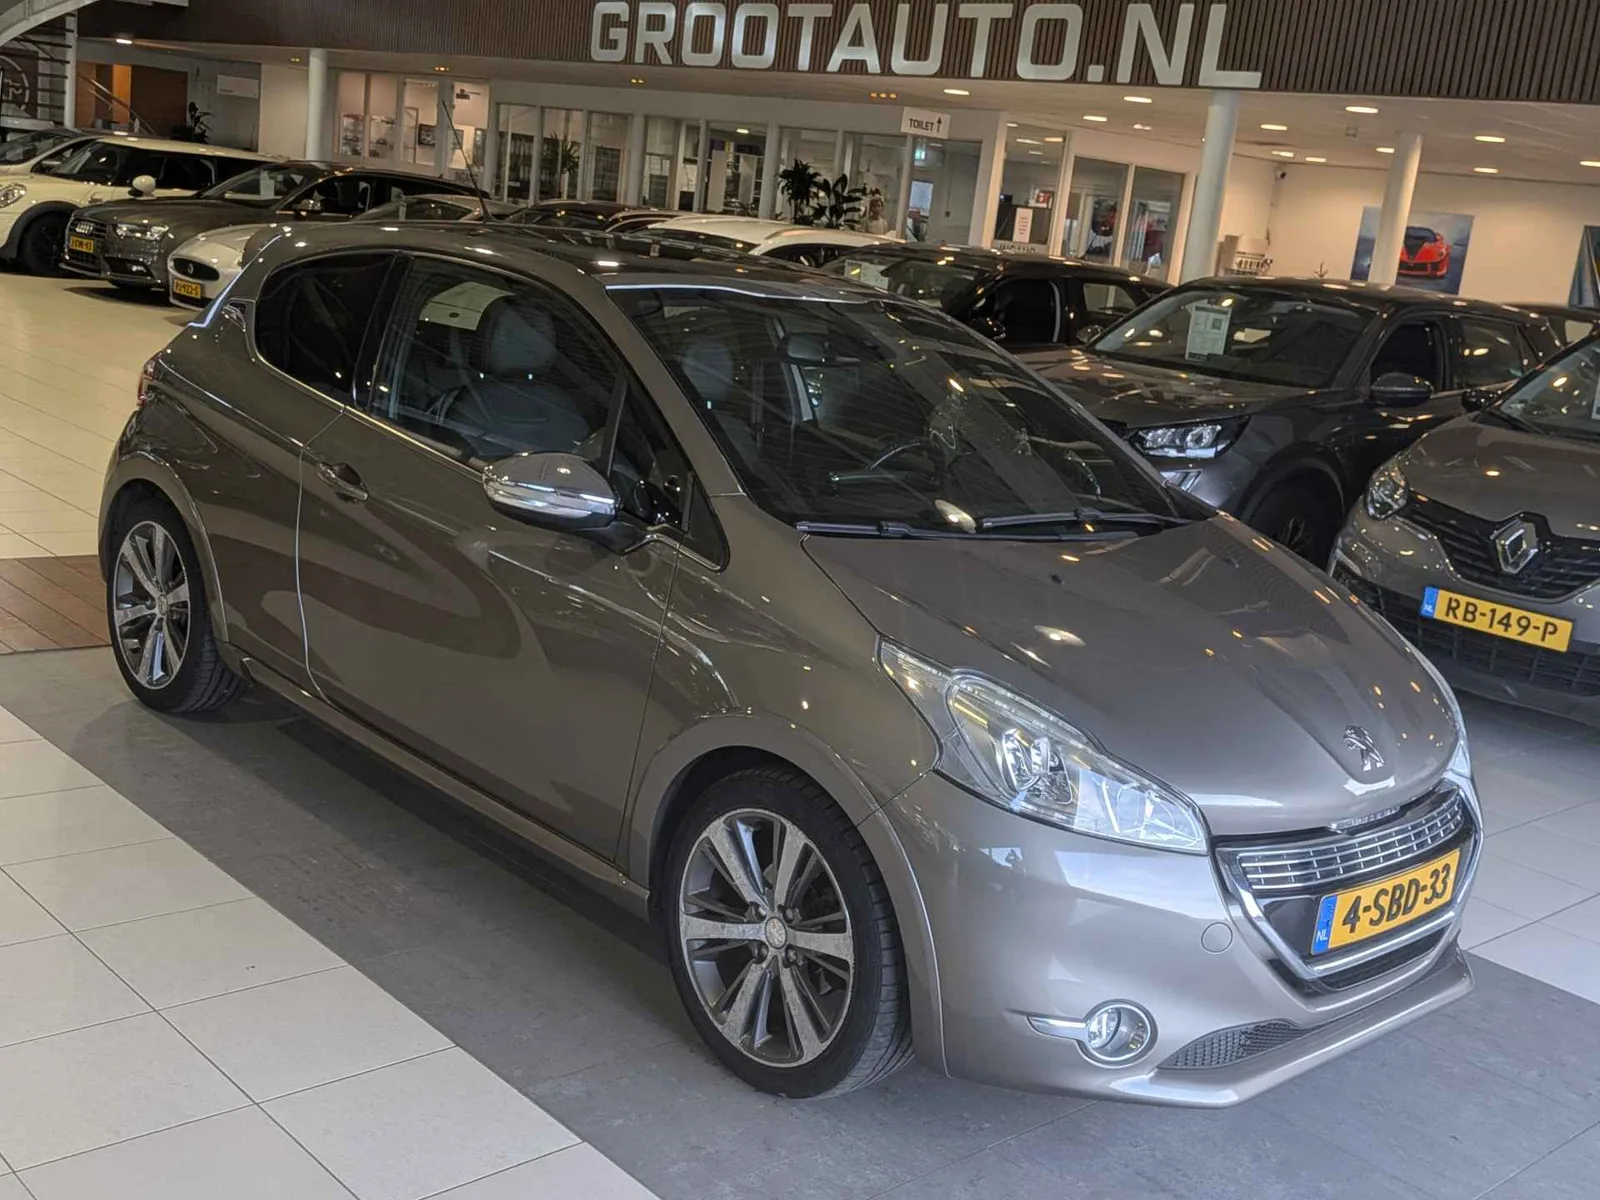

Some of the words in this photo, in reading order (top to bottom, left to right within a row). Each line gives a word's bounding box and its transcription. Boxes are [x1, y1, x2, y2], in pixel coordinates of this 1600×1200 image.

[591, 1, 1262, 88] GROOTAUTO.NL
[909, 118, 934, 131] TOILET
[1445, 597, 1558, 642] RB-149-P
[1316, 928, 1328, 942] NL
[1342, 863, 1450, 934] 4-SBD-33
